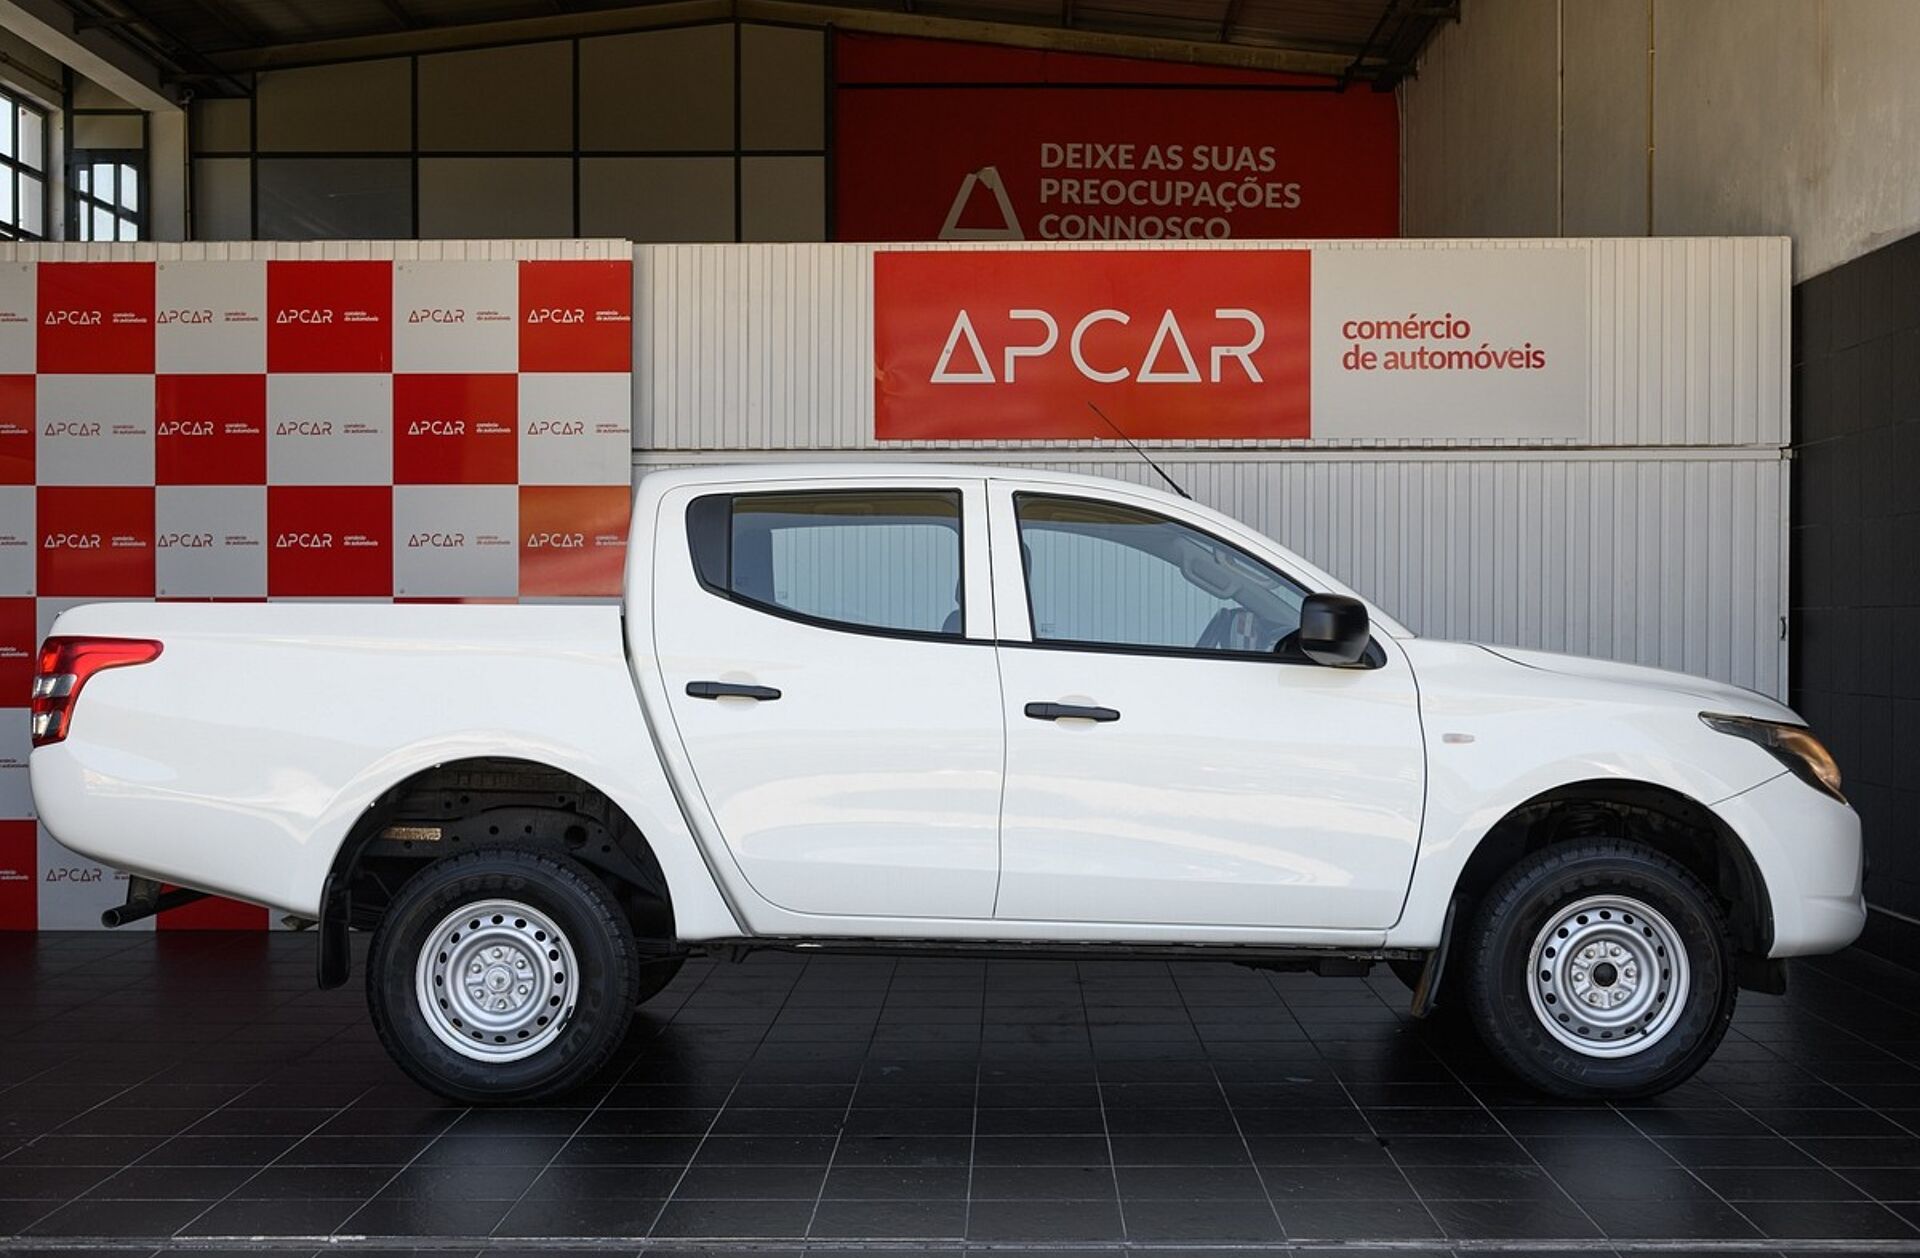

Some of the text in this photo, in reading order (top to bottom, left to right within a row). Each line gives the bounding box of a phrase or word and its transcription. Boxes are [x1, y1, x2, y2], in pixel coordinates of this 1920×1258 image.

[1040, 143, 1276, 172] DEIXE AS SUAS
[1039, 176, 1301, 214] PREOCUPAÇÕES
[1038, 213, 1232, 240] CONNOSCO
[45, 310, 102, 325] APCAR
[157, 310, 213, 324] APCAR
[276, 310, 333, 324] APCAR
[408, 309, 465, 323] APCAR
[528, 309, 585, 323] APCAR
[1343, 313, 1471, 340] comércio
[930, 308, 1264, 384] APCAR
[1343, 343, 1546, 371] de automóveis
[45, 422, 101, 437] APCAR
[157, 422, 214, 436] APCAR
[276, 422, 333, 436] APCAR
[408, 421, 465, 435] APCAR
[528, 422, 585, 436] APCAR
[44, 533, 101, 548] APCAR
[158, 533, 214, 548] APCAR
[276, 533, 332, 548] APCAR
[408, 533, 465, 547] APCAR
[528, 533, 585, 548] APCAR
[46, 868, 102, 882] APCAR
